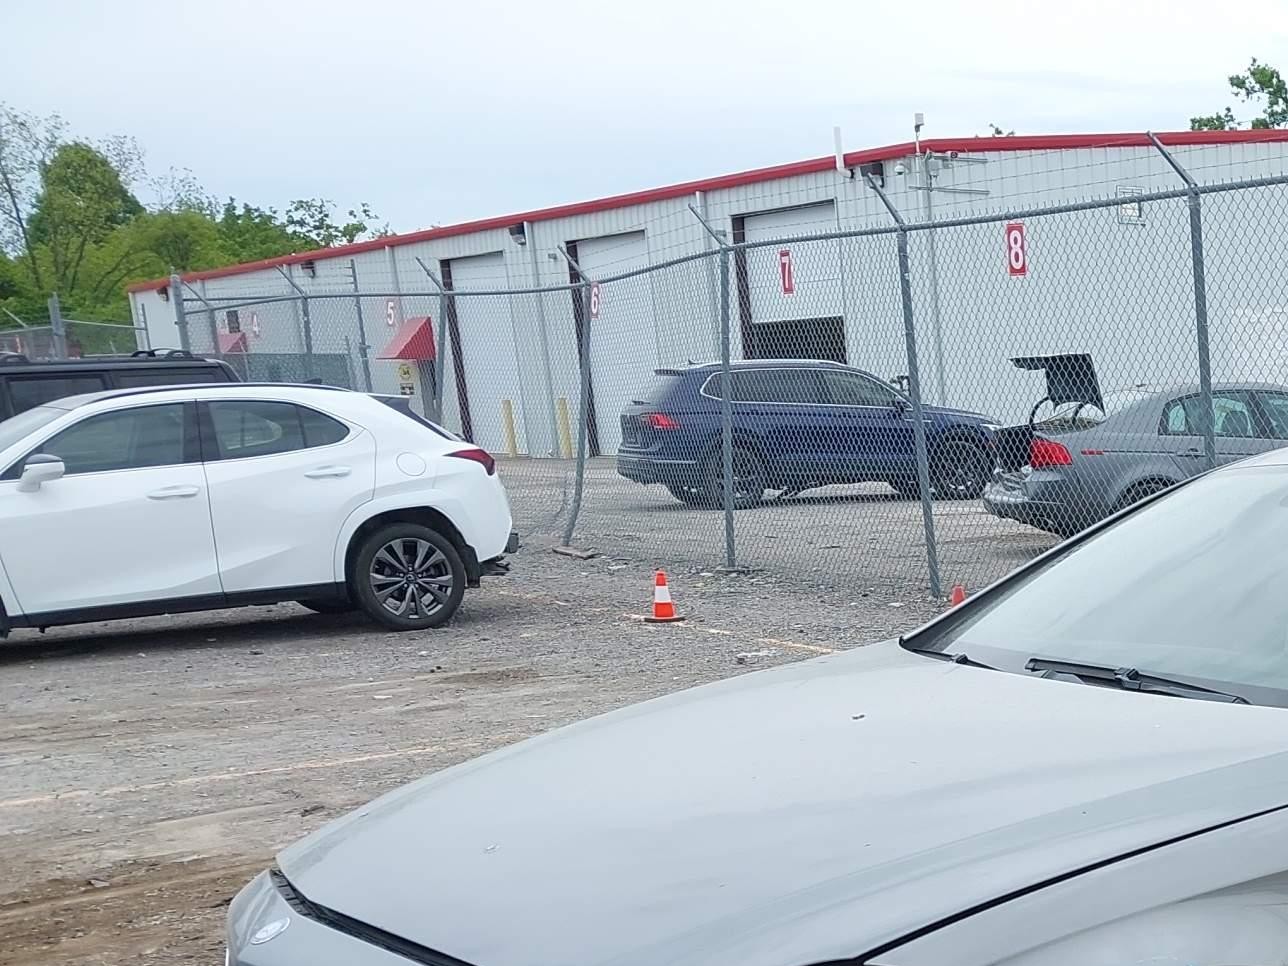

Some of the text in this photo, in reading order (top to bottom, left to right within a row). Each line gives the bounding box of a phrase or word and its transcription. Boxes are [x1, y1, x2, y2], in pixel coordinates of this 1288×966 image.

[1010, 229, 1024, 270] 8
[781, 256, 790, 289] 7
[386, 301, 395, 325] 5
[591, 287, 598, 314] 6
